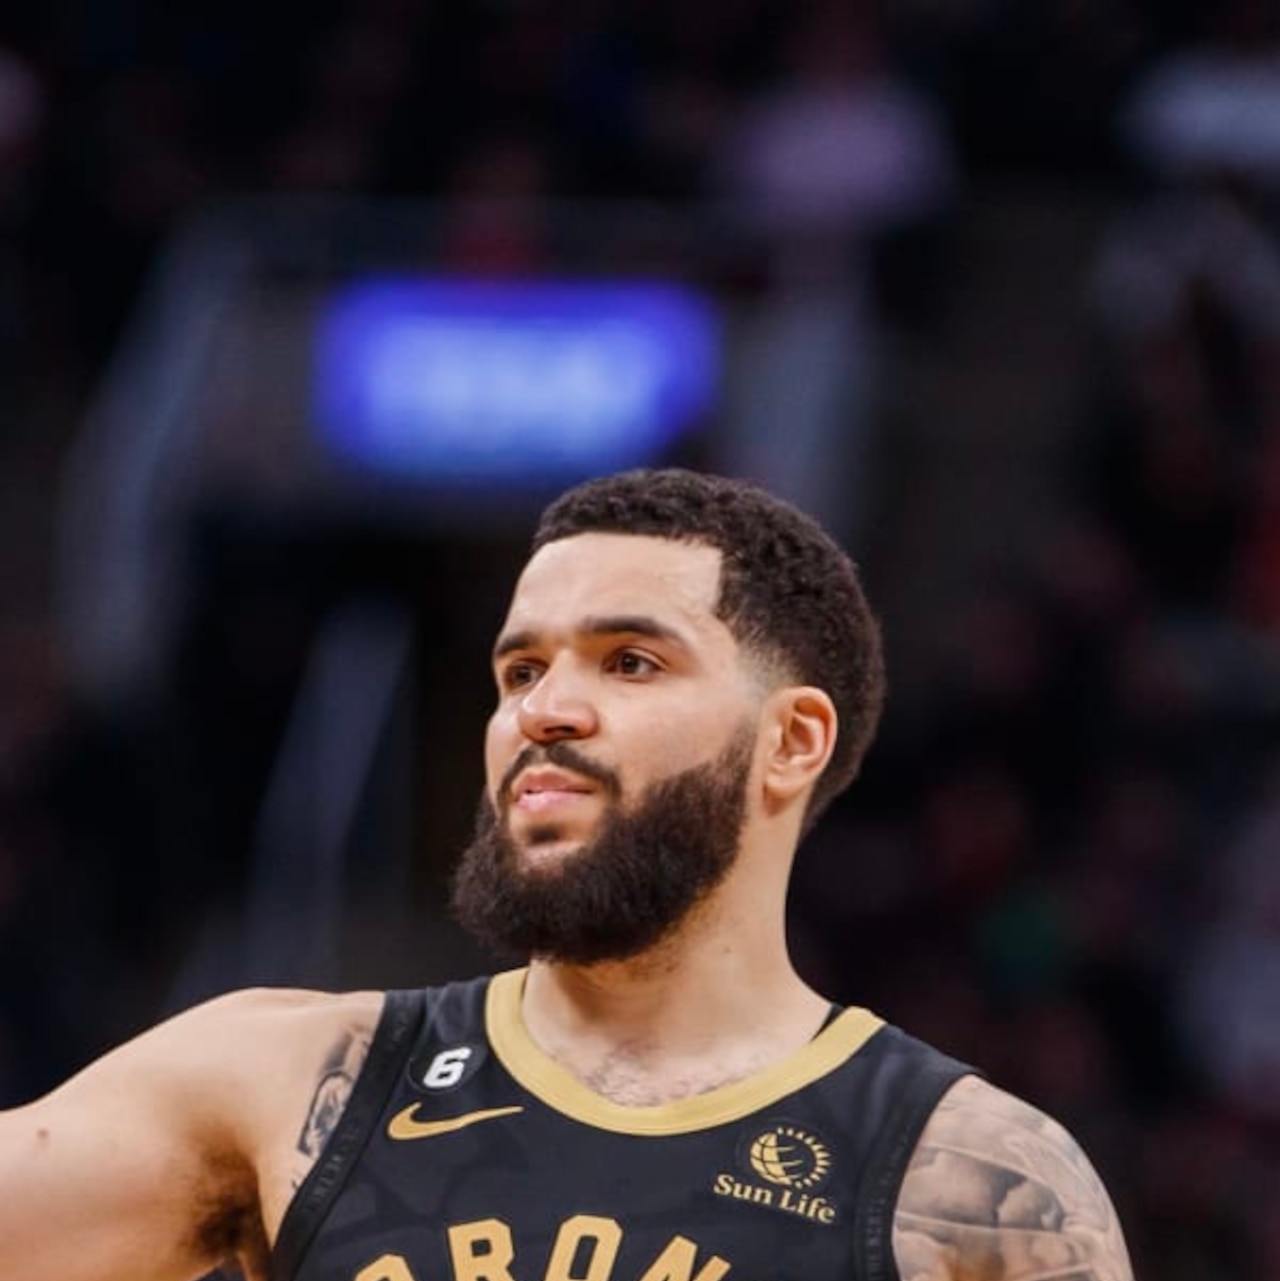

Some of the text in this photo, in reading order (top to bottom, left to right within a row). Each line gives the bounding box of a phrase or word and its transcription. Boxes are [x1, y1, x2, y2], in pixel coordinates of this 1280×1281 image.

[423, 1045, 472, 1089] 6
[713, 1173, 836, 1224] Sun Life
